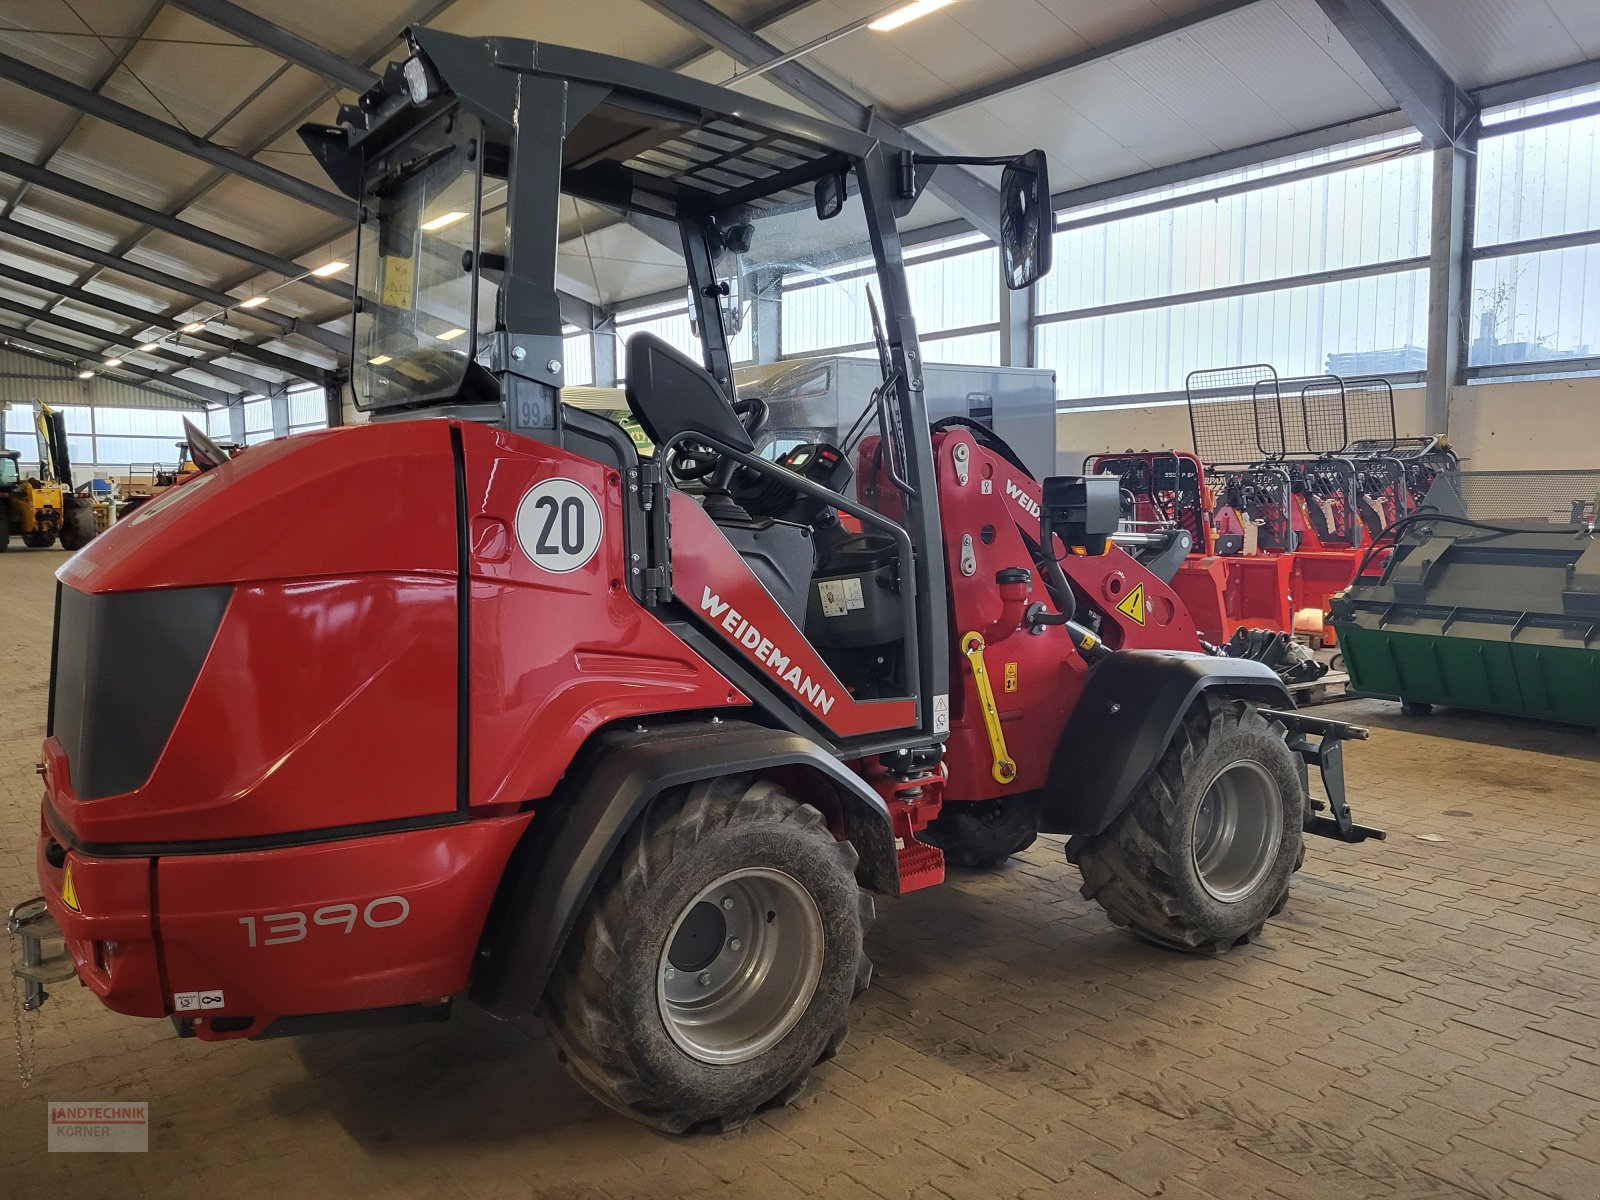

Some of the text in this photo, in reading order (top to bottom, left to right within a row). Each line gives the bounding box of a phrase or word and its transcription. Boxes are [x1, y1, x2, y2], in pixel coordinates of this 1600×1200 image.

[521, 402, 541, 426] 99
[534, 495, 584, 555] 20
[700, 585, 836, 715] WEIDEMANN
[239, 895, 410, 948] 1390
